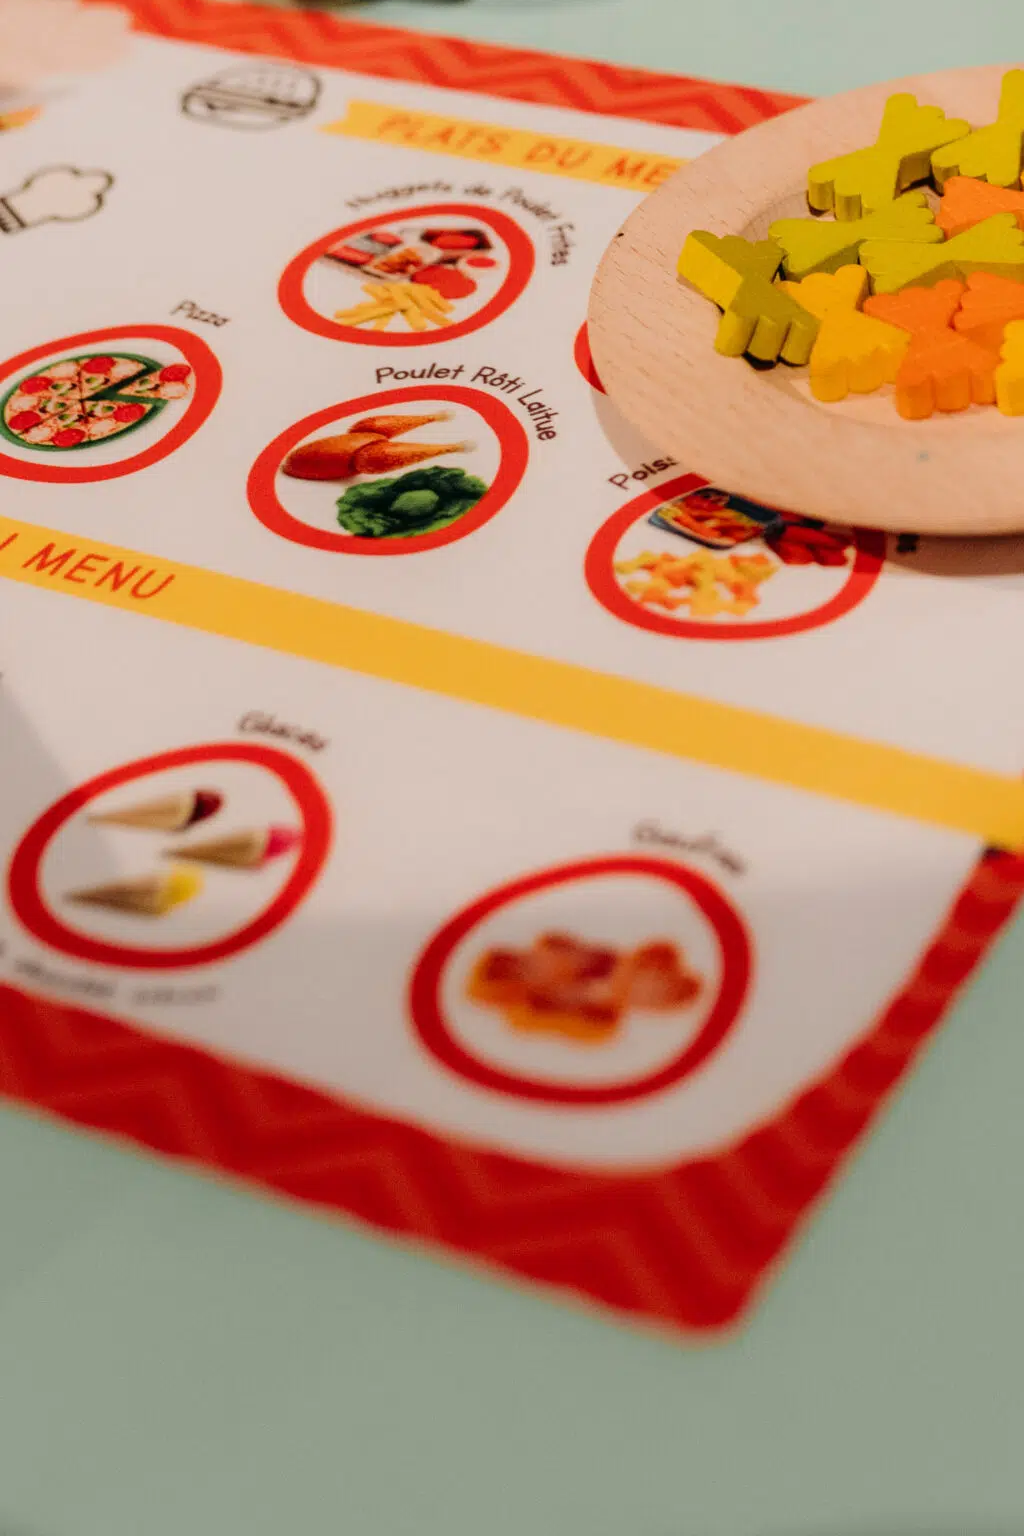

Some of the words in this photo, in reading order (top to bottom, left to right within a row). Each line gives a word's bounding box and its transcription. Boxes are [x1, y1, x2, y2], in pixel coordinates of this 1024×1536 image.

[376, 114, 509, 156] PLATS
[523, 140, 593, 169] DU
[603, 156, 681, 185] ME
[169, 299, 231, 327] Pizza
[375, 362, 465, 384] Poulet
[470, 365, 527, 394] Rôti
[517, 388, 560, 441] Laitue
[608, 456, 679, 492] Pois
[21, 542, 176, 599] MENU
